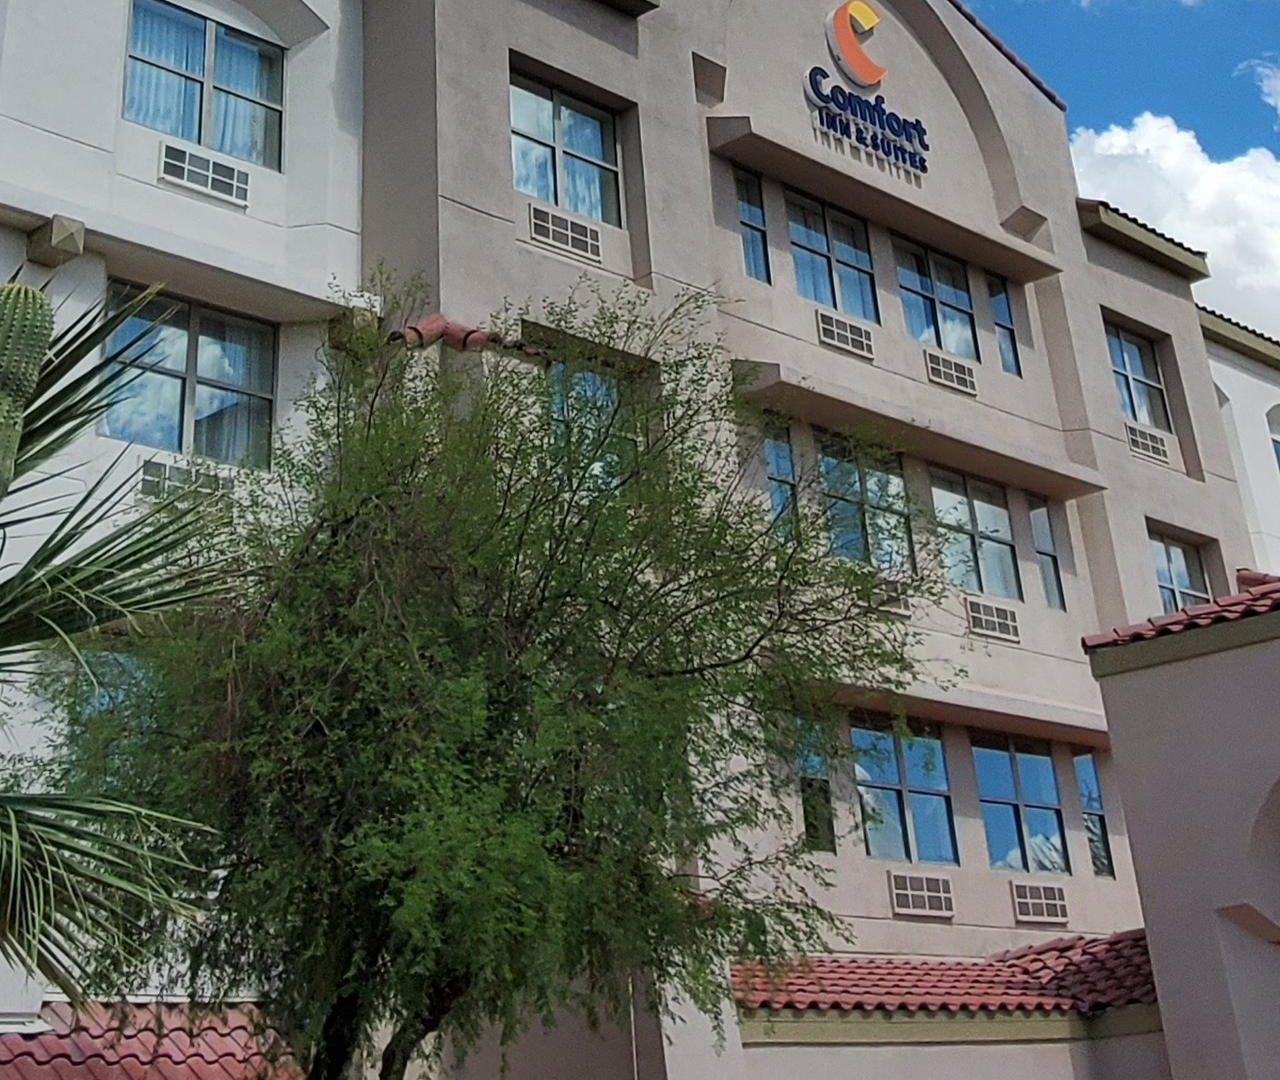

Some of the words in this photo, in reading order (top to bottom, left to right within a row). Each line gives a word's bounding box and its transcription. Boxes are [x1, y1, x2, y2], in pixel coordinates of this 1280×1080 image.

[808, 66, 930, 152] Comfort
[818, 108, 852, 140] INN
[855, 129, 870, 147] &
[870, 135, 928, 173] SUITES
